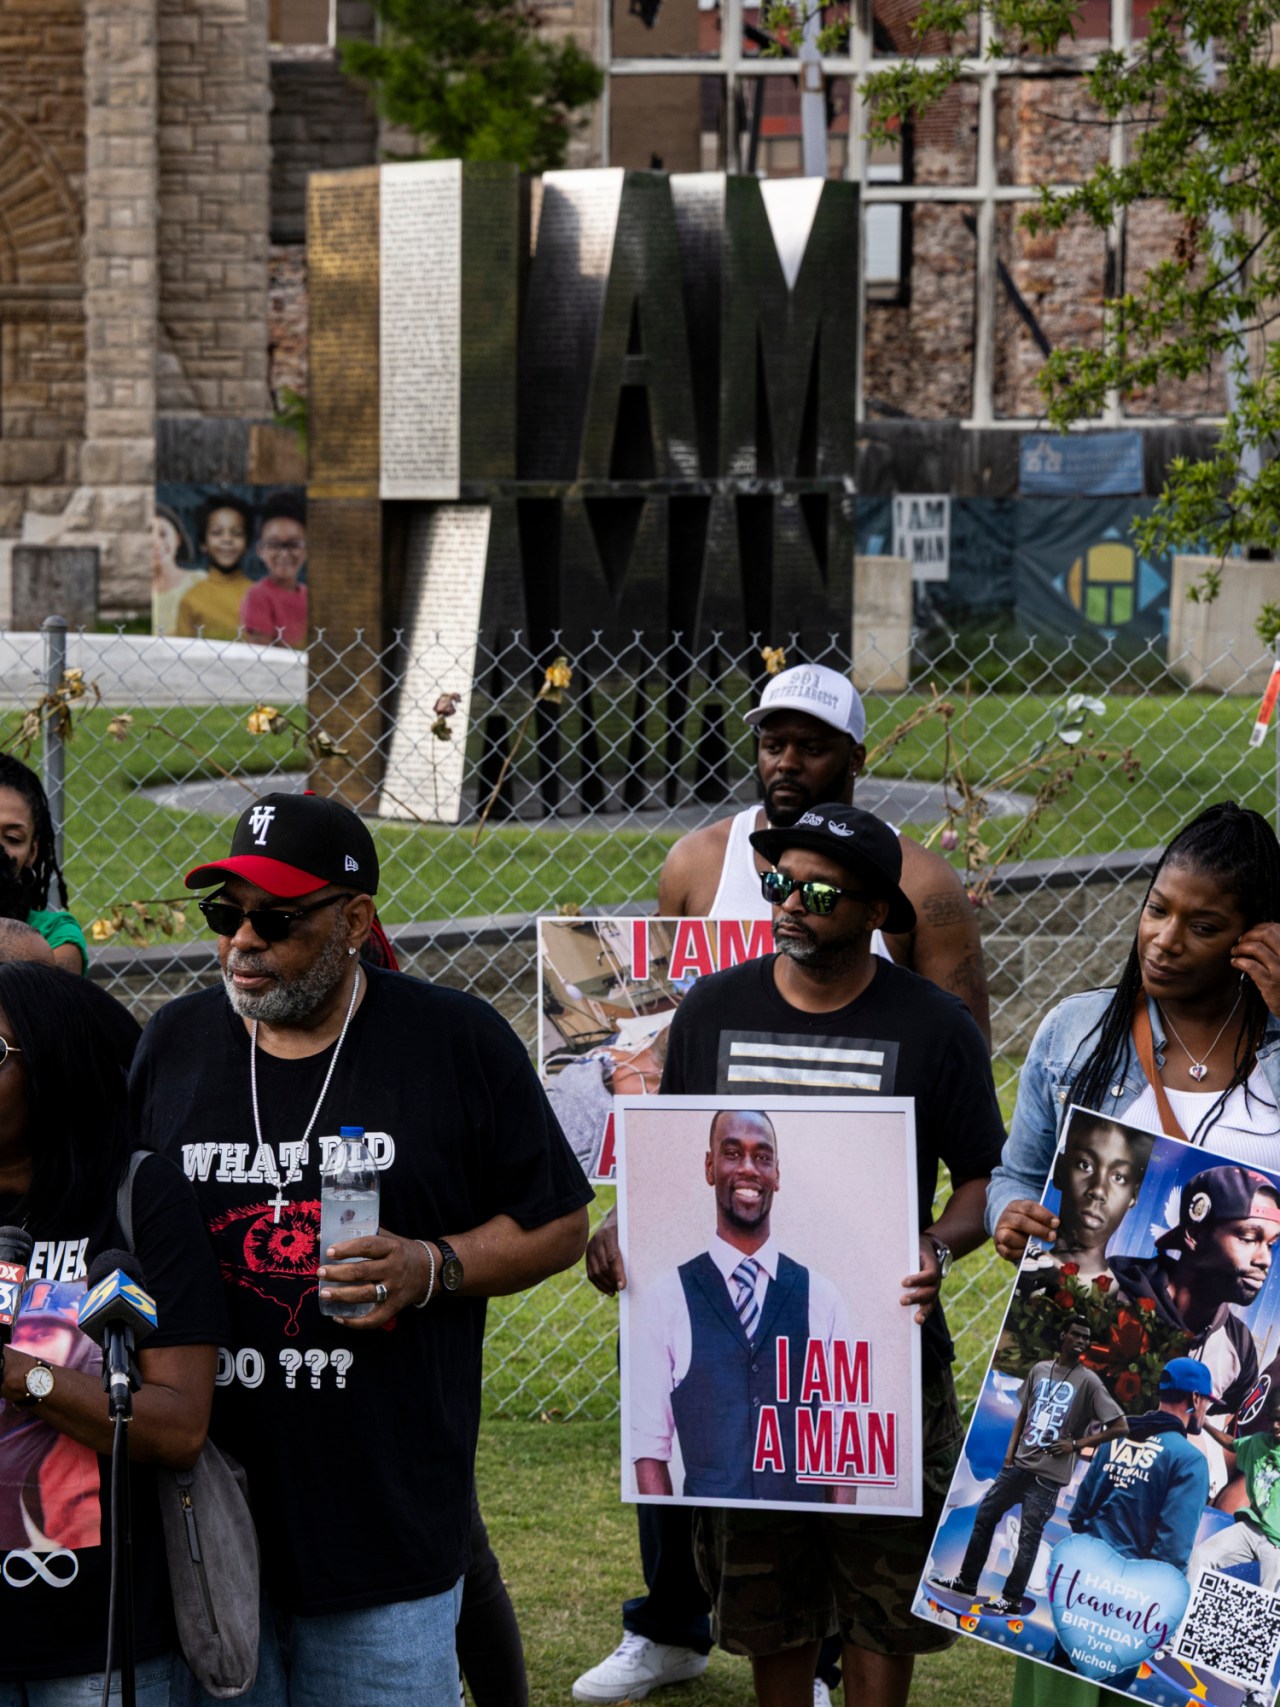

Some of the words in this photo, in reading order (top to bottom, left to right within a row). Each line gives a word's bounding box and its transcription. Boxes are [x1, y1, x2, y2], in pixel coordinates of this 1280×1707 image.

[897, 500, 903, 528] I
[908, 500, 945, 530] AM
[789, 671, 821, 688] 901
[631, 920, 650, 980] I
[181, 1141, 309, 1184] WHAT
[319, 1132, 396, 1178] DID
[120, 1284, 157, 1316] 5
[215, 1346, 266, 1389] DO
[278, 1347, 354, 1389] ???
[776, 1336, 790, 1403] I
[800, 1336, 872, 1405] AM
[752, 1405, 786, 1473] A
[795, 1406, 897, 1478] MAN
[1047, 1563, 1169, 1650] Heavenly
[1085, 1572, 1152, 1607] HAPPY
[1061, 1611, 1144, 1651] BIRTHDAY
[1087, 1635, 1113, 1653] Tyre
[1071, 1647, 1118, 1674] Nichols
